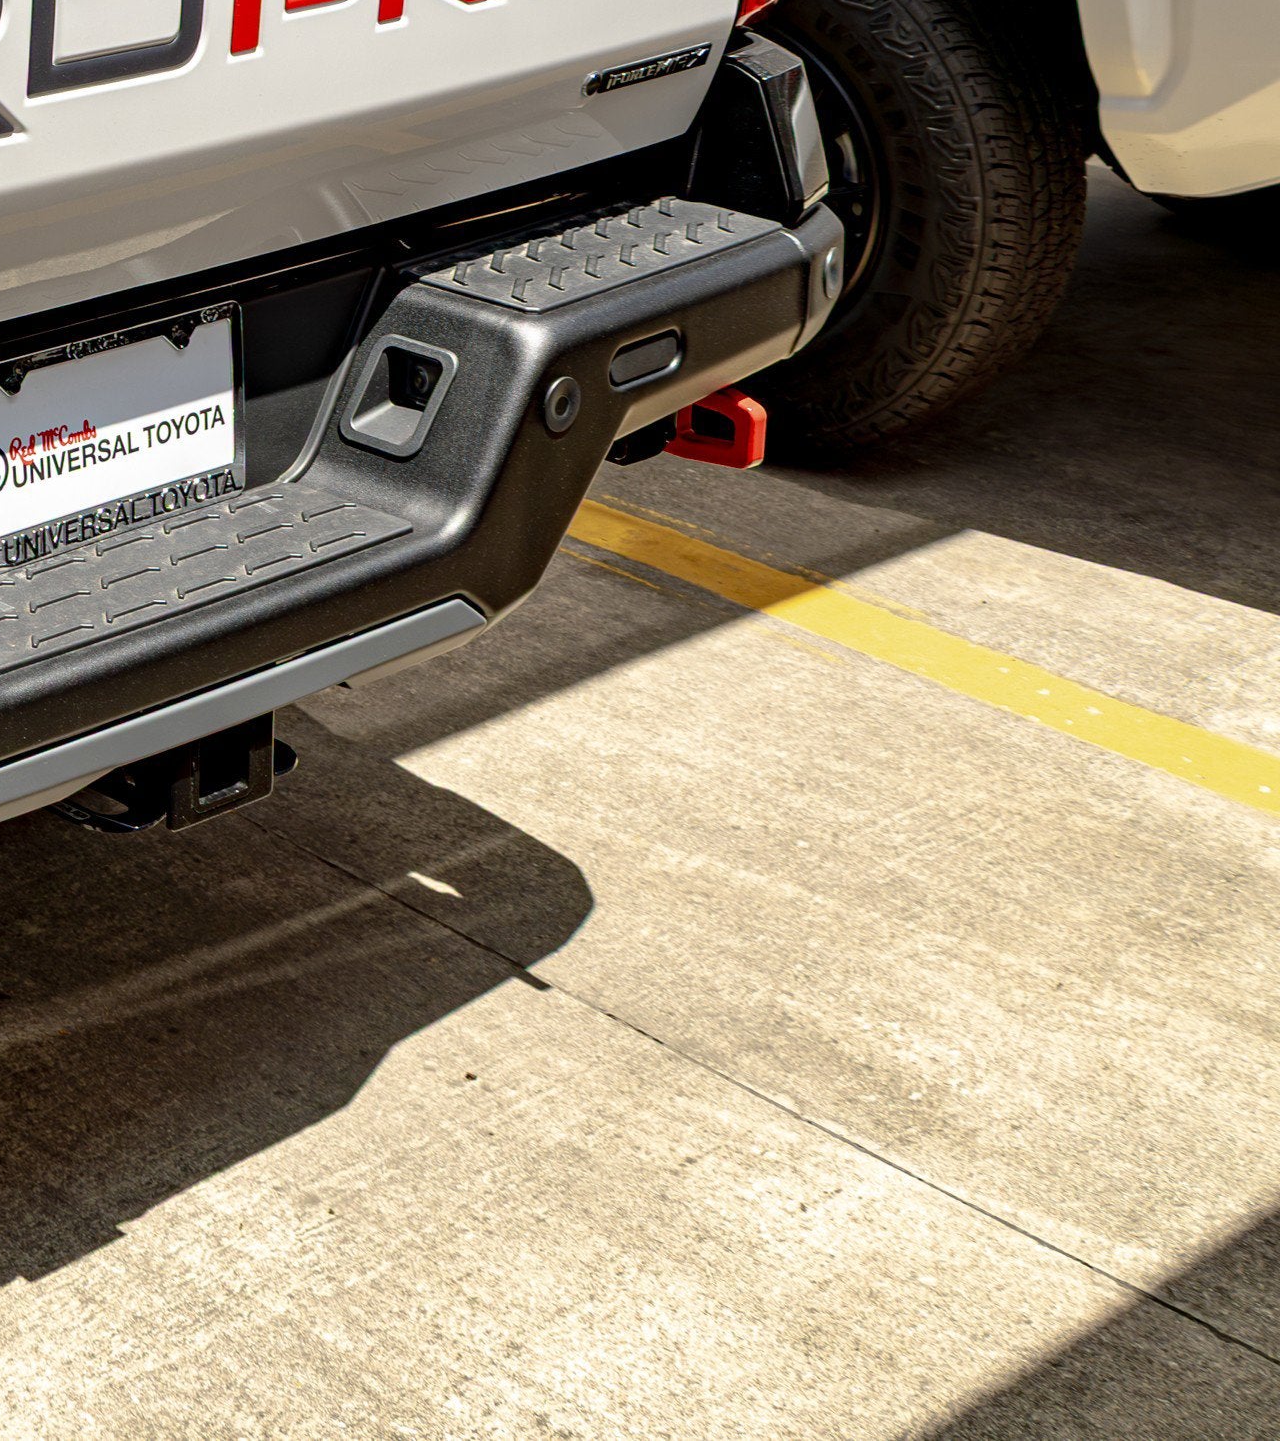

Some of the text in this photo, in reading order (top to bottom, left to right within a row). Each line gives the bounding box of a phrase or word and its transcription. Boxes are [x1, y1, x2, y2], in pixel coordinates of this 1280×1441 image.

[9, 419, 97, 465] Red McCombs
[12, 405, 225, 488] UNIVERSAL TOYOTA
[2, 469, 241, 565] UNIVERSAL TOYOTA
